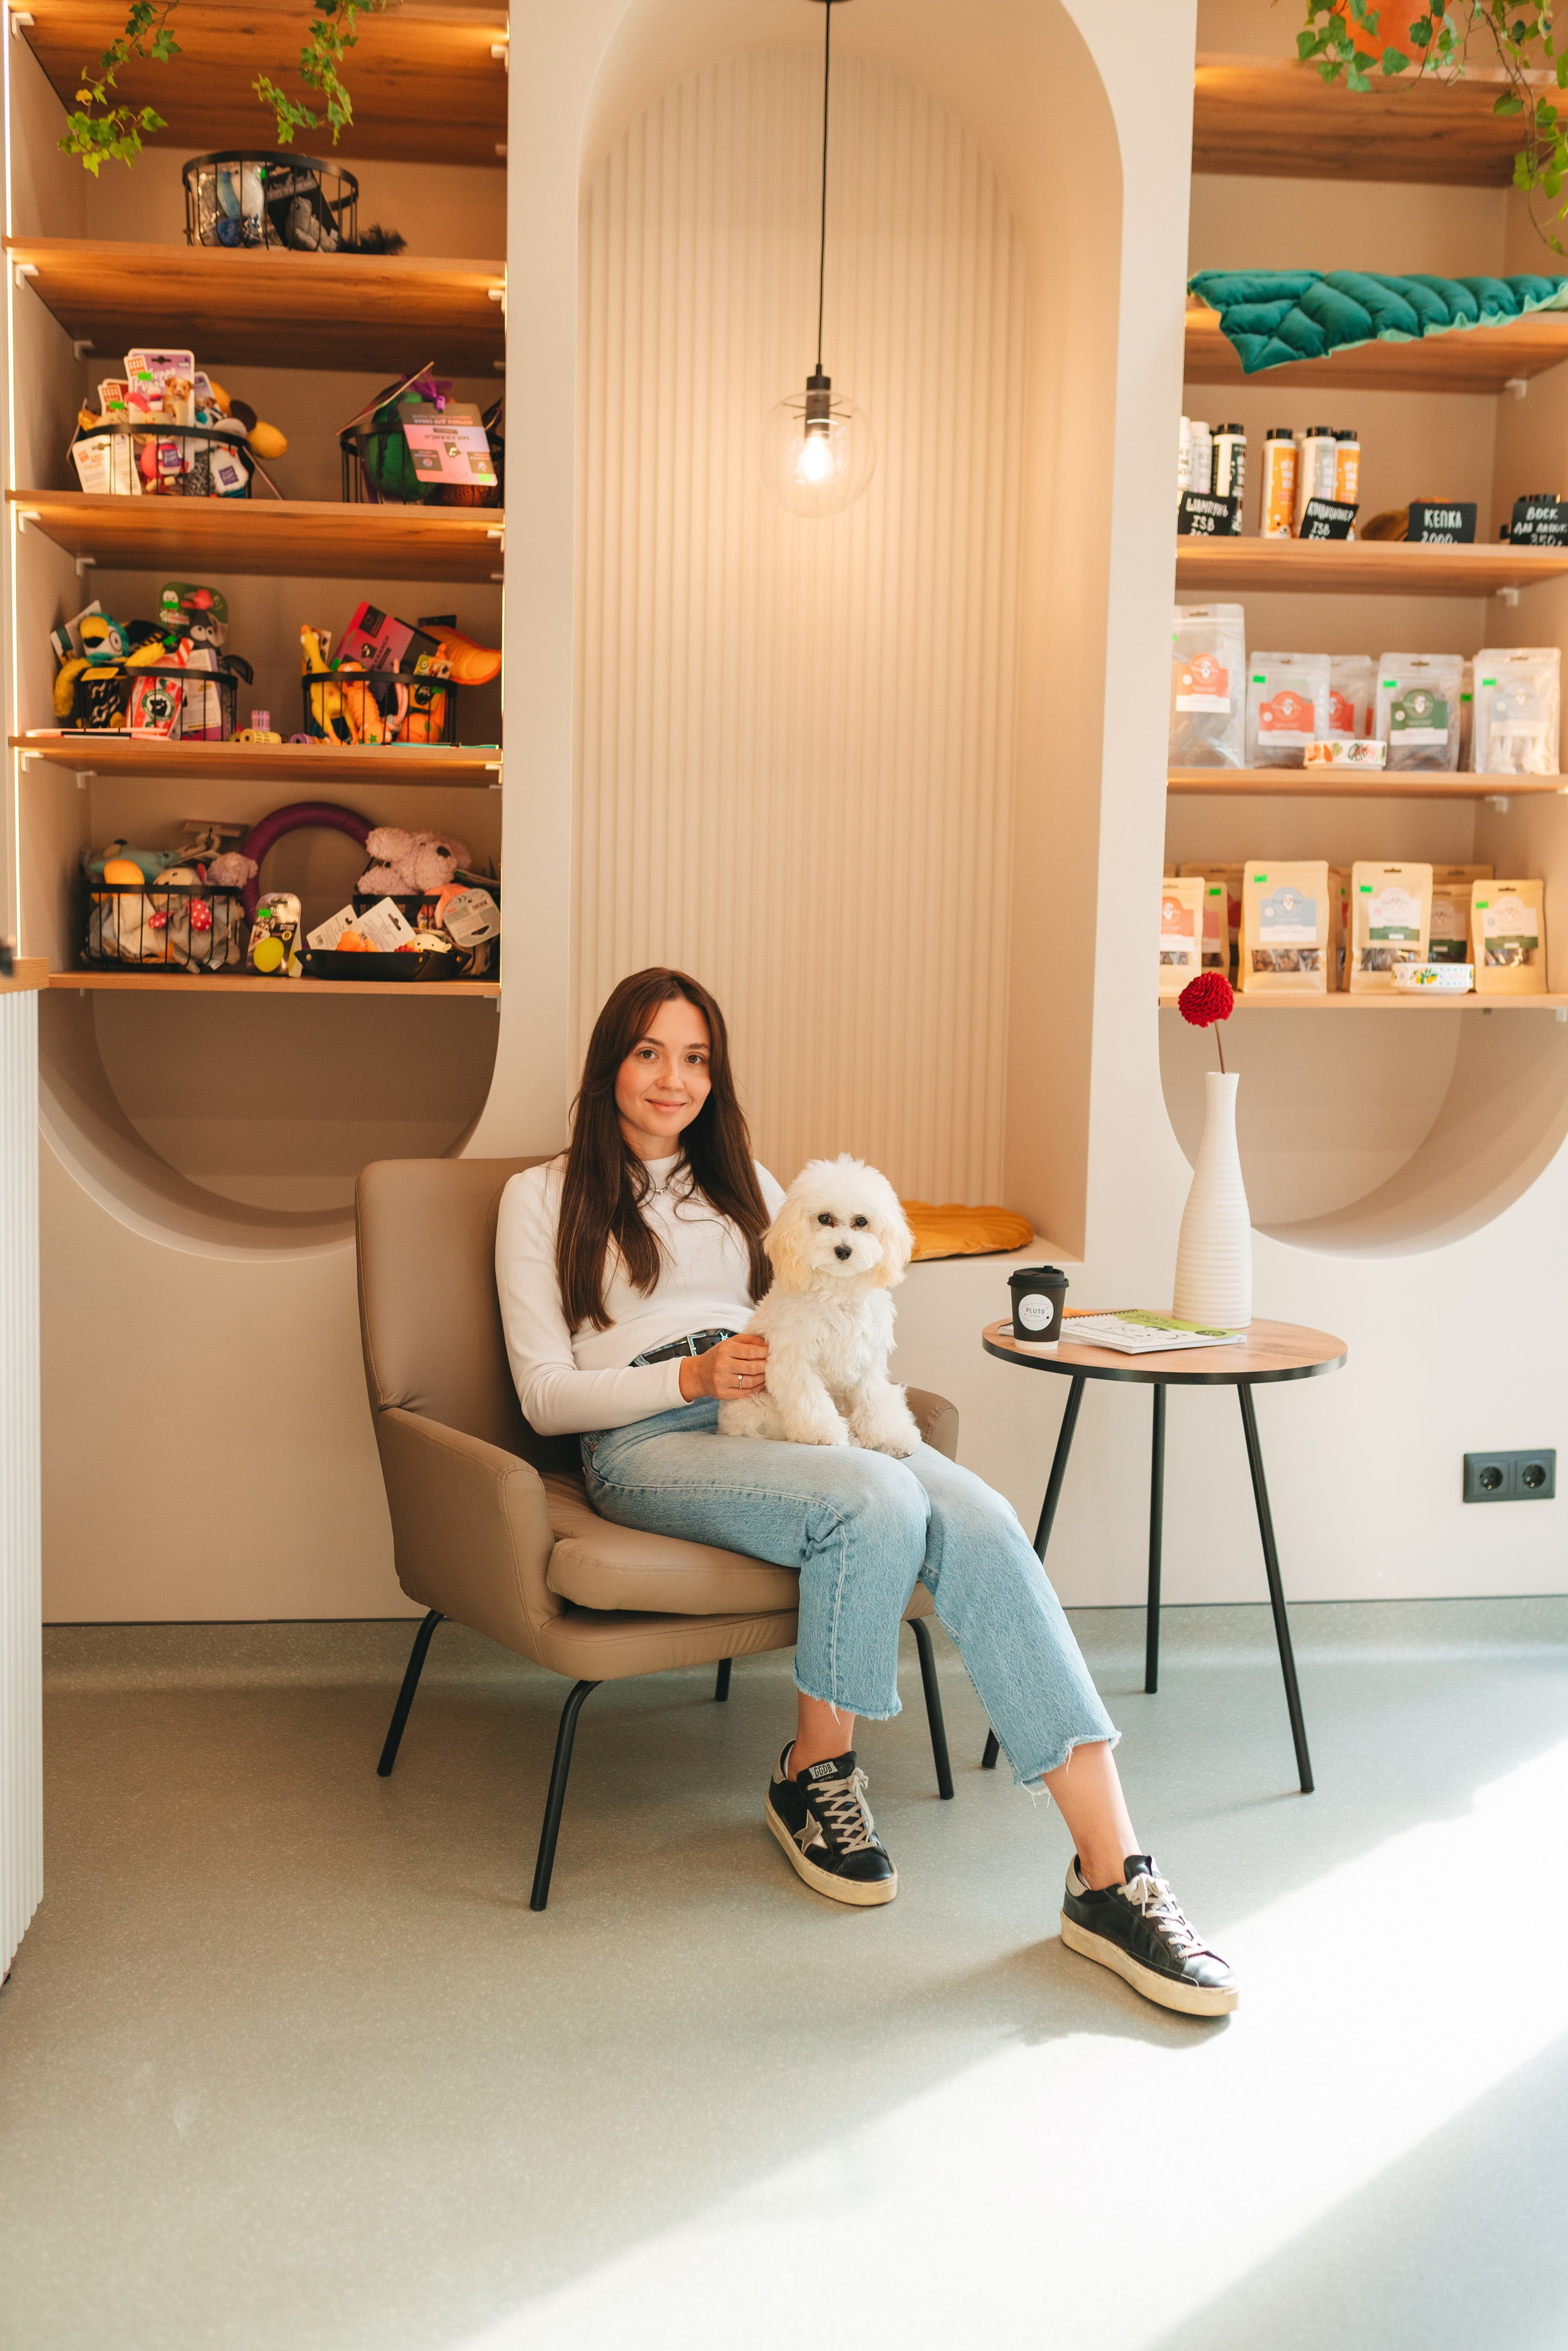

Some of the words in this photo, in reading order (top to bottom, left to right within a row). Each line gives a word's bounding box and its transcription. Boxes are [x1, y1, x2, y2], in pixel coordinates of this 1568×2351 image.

[1186, 497, 1229, 518] ШАМПУНЬ
[1526, 506, 1559, 521] ВОСК
[1191, 515, 1215, 532] ISB
[1424, 508, 1462, 529] КЕПКА
[813, 1764, 832, 1777] GGDB
